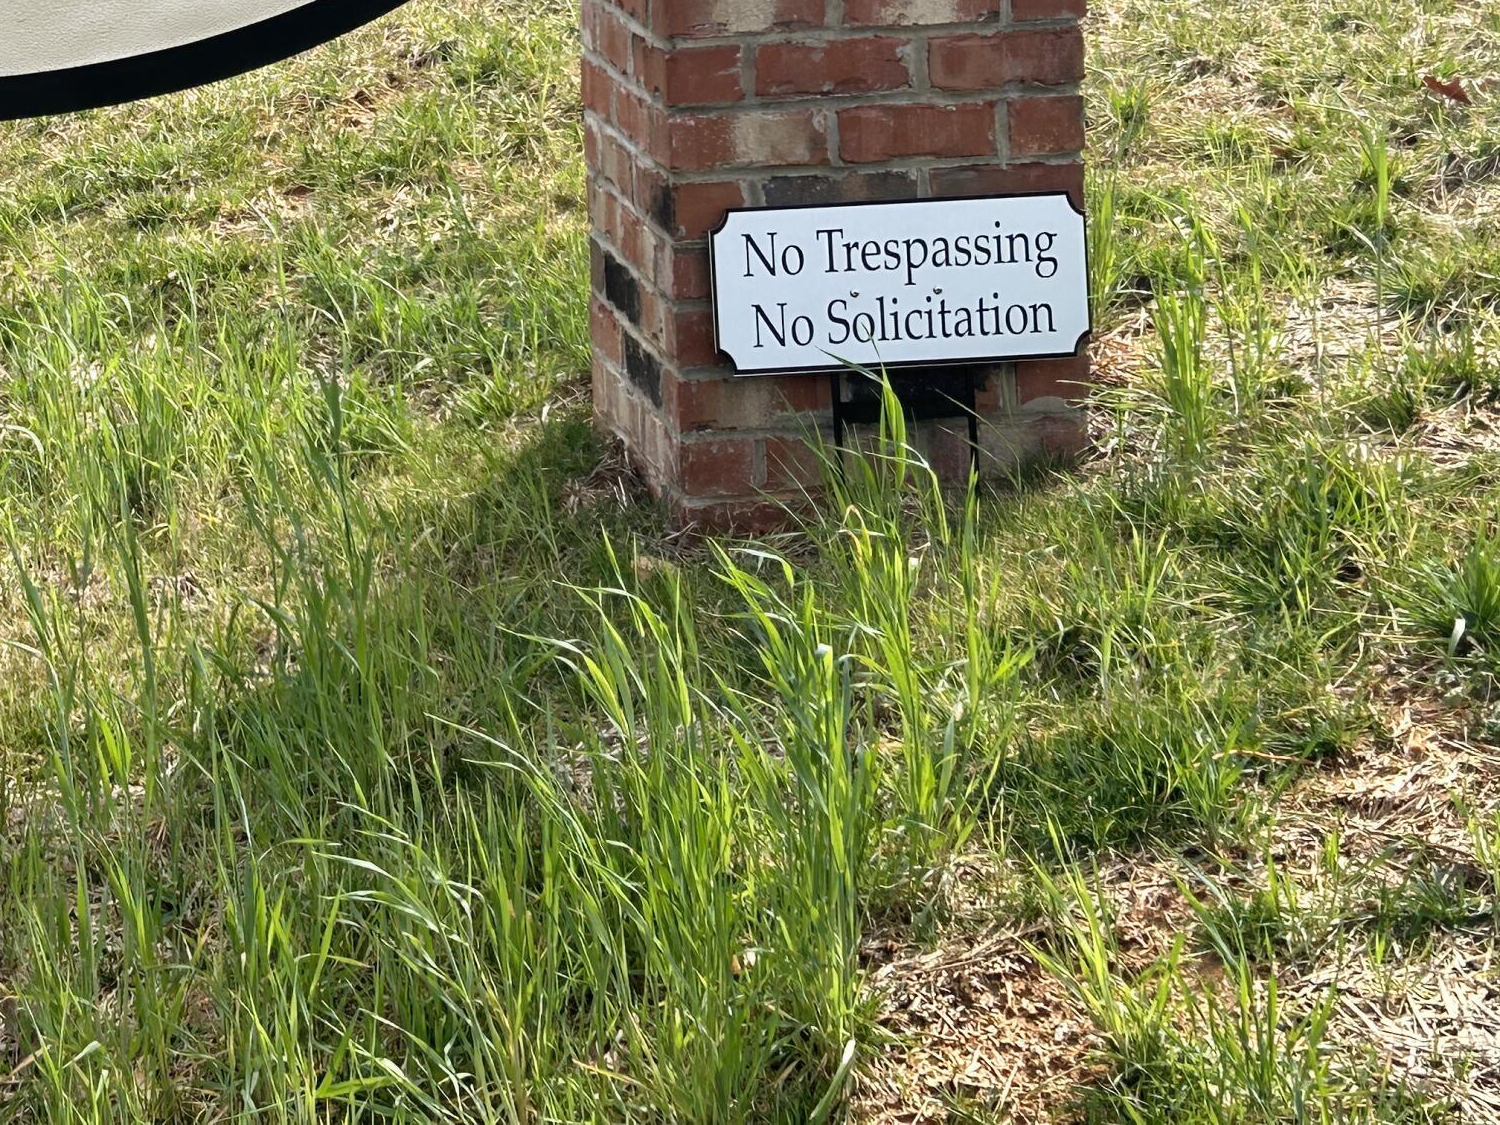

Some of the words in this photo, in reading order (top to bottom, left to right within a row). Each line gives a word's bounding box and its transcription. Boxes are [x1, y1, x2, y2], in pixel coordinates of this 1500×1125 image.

[741, 232, 804, 278] No
[816, 221, 1059, 286] Trespassing
[751, 302, 815, 348] No
[828, 292, 1058, 345] Solicitation
